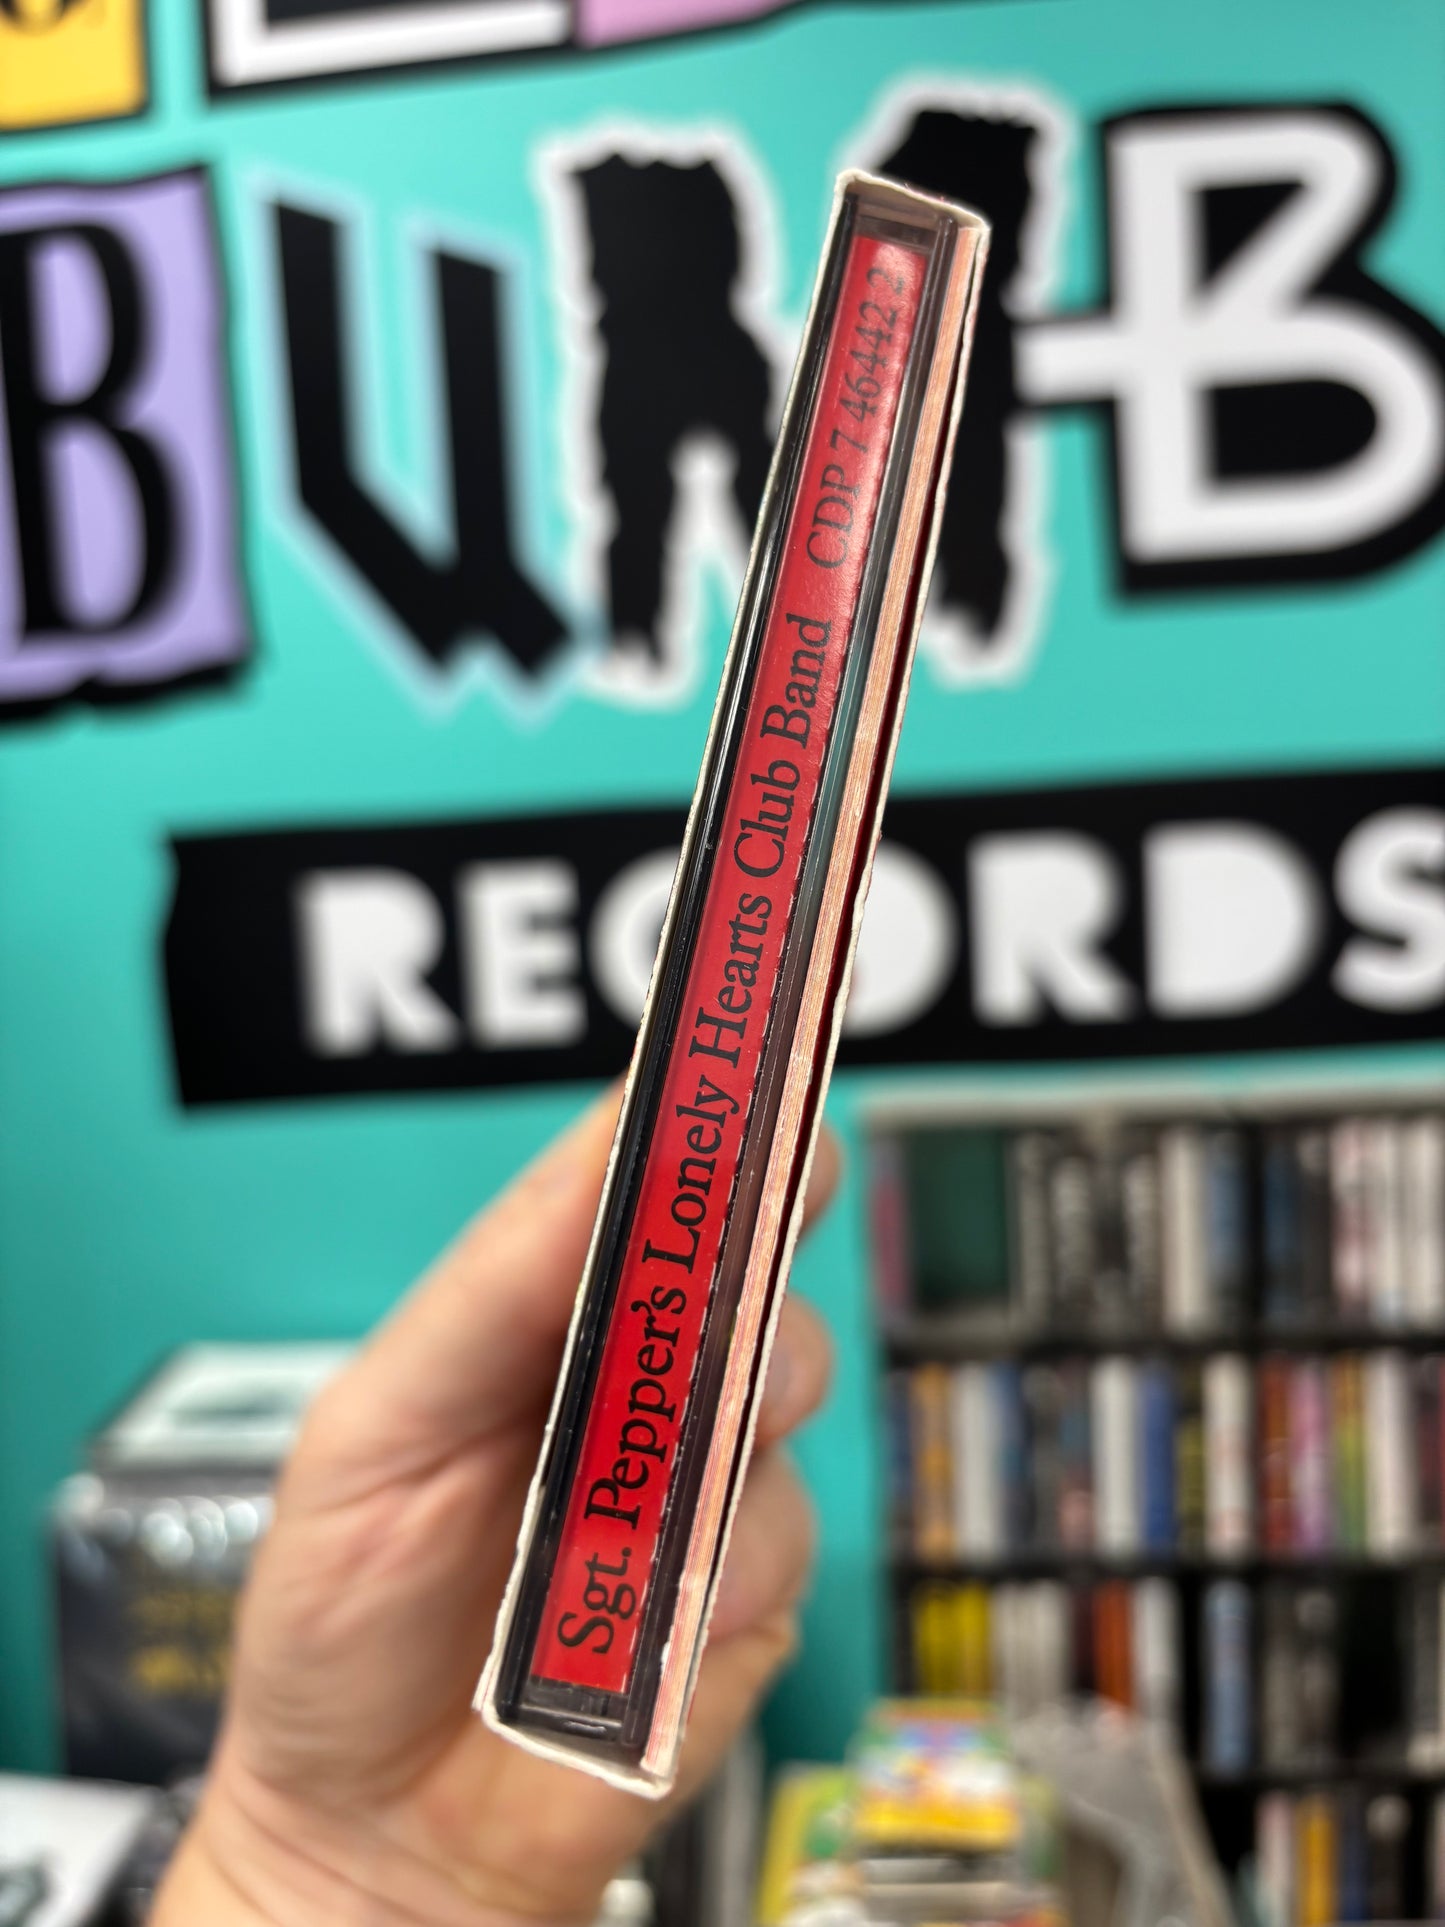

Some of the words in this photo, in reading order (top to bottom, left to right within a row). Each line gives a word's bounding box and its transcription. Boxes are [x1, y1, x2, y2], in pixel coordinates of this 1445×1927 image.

[806, 464, 860, 569] CDP
[760, 614, 832, 749] Band
[733, 759, 801, 878] Club
[688, 893, 773, 1069] Hearts
[641, 1074, 740, 1274] Lonely
[584, 1286, 688, 1530] Pepper's
[557, 1546, 638, 1655] Sgt.
